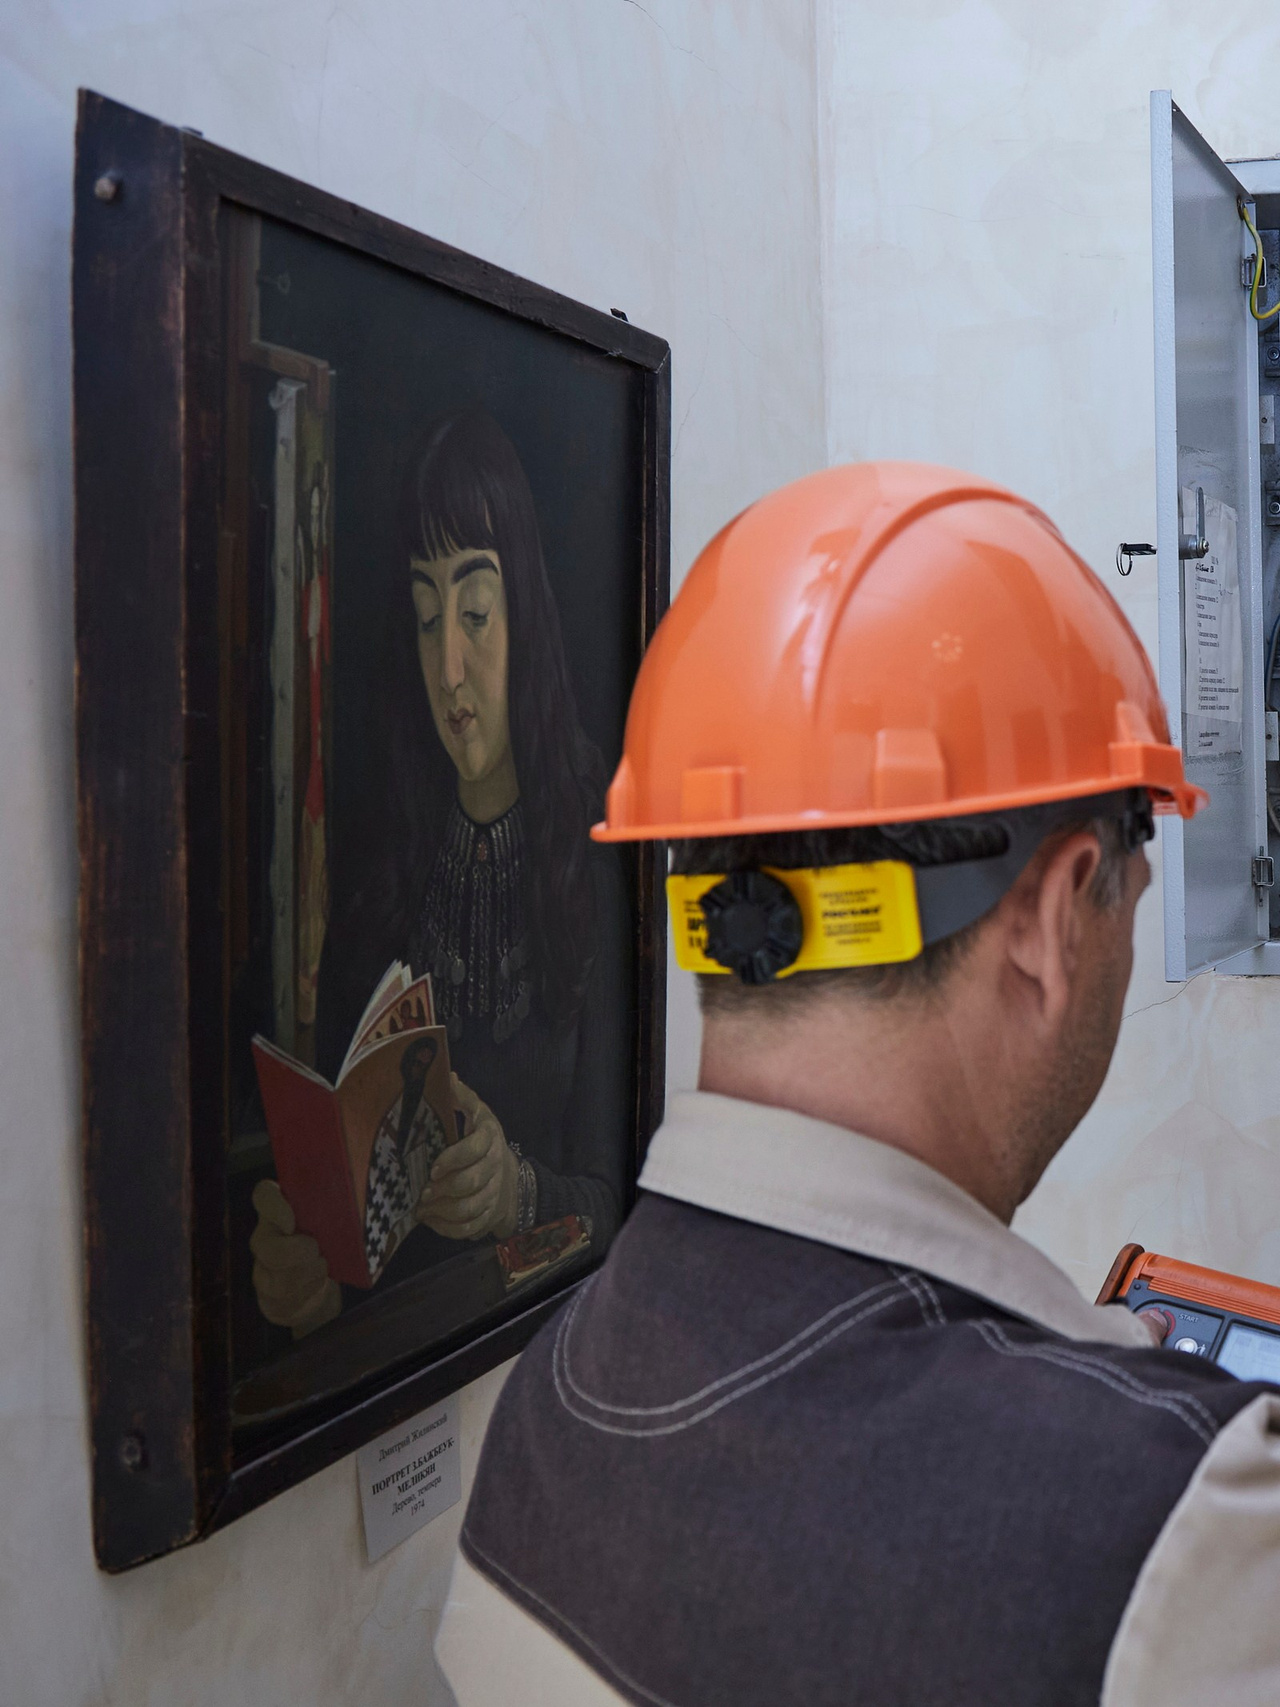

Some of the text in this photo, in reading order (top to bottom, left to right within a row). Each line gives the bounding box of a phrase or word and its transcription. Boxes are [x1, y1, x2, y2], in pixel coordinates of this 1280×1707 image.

[1179, 1313, 1199, 1323] START
[379, 1435, 411, 1462] Дмитрий
[371, 1464, 412, 1495] ПОРТРЕТ
[397, 1463, 436, 1493] МЕЛИКЯН
[410, 1499, 425, 1516] 1974
